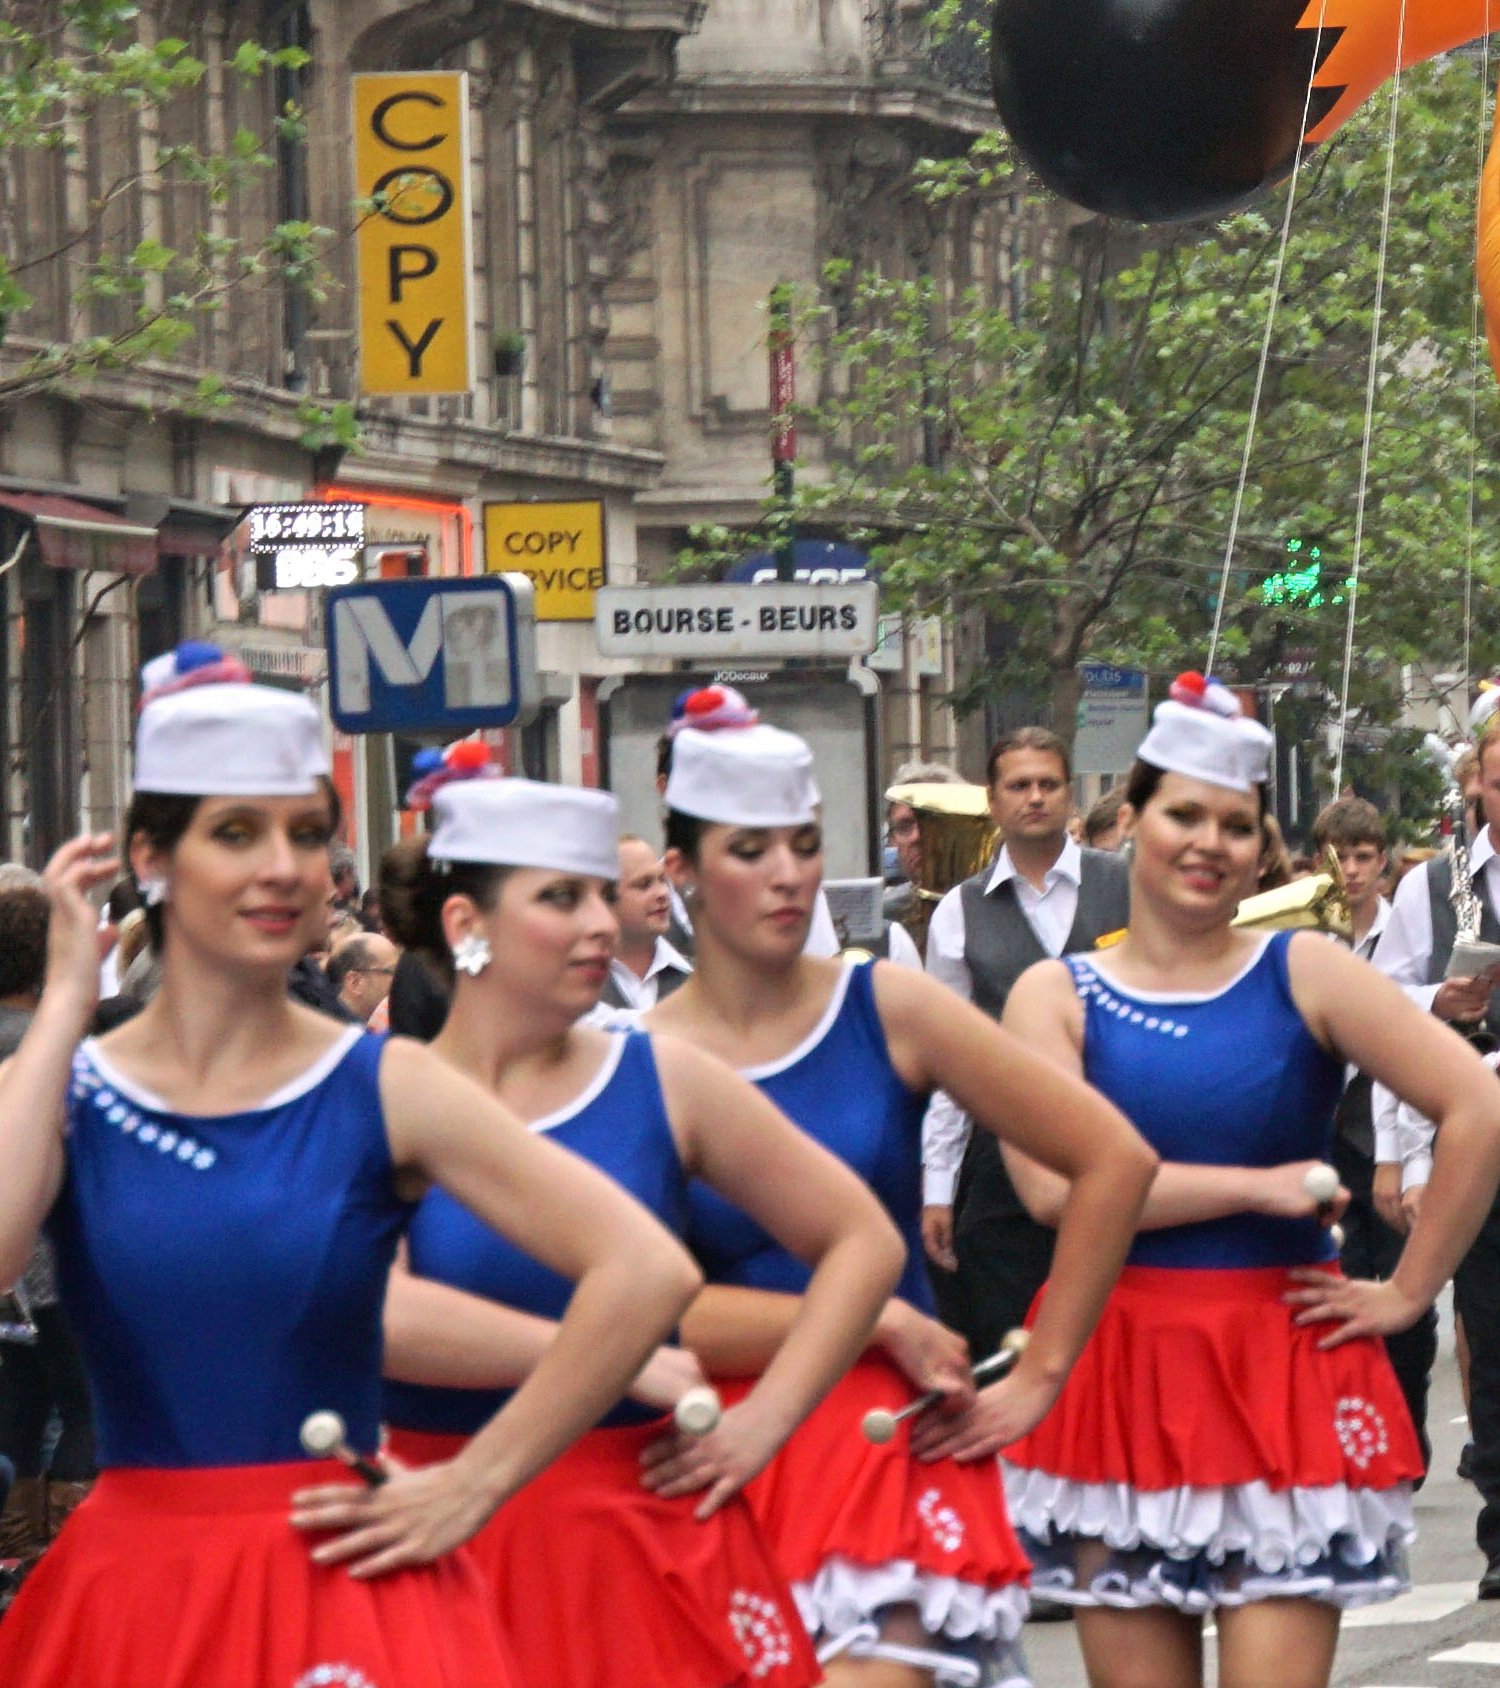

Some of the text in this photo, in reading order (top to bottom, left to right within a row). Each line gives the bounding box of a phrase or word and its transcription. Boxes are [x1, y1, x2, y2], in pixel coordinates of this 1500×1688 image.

[371, 90, 454, 378] COPY
[504, 529, 583, 554] COPY
[492, 567, 602, 591] RVICE
[613, 607, 735, 634] BOURSE
[759, 604, 858, 631] BEURS
